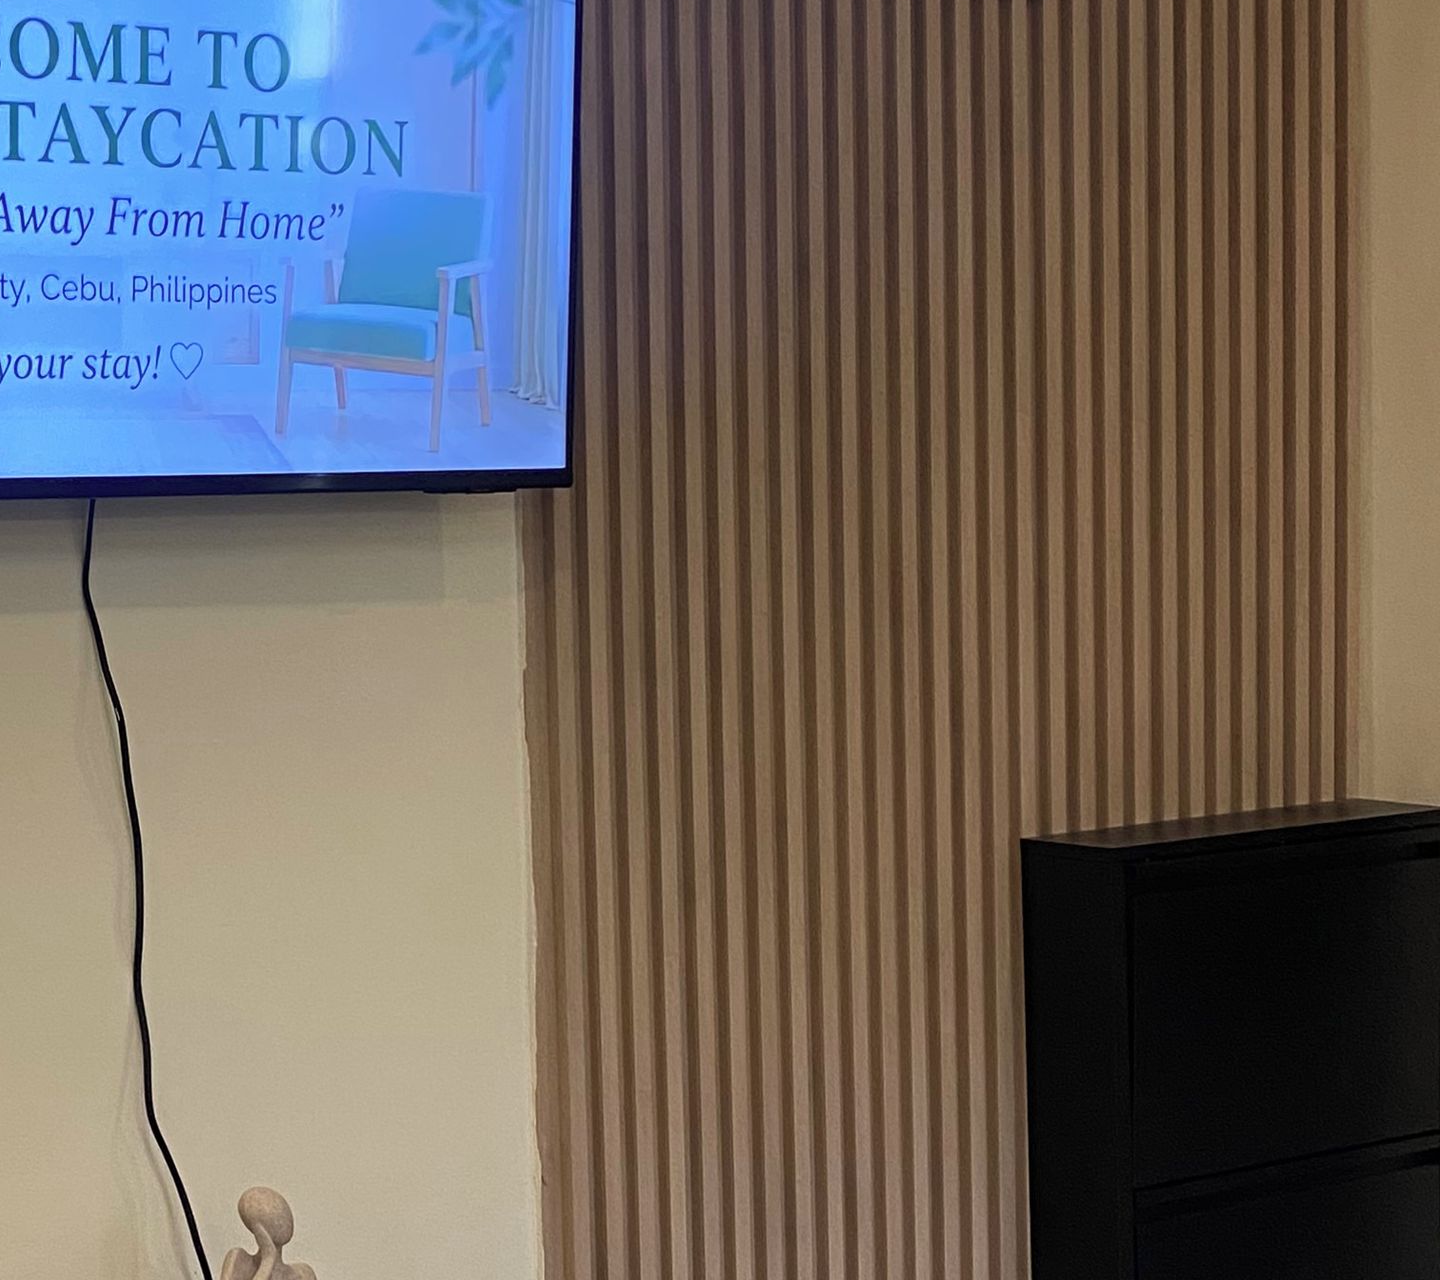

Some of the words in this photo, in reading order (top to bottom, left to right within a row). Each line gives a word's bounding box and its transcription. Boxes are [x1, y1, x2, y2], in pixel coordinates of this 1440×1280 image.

[198, 31, 291, 93] TO
[107, 197, 204, 239] From
[218, 201, 344, 243] Home”
[41, 273, 122, 305] Cebu,
[131, 275, 278, 310] Philippines
[82, 345, 163, 390] stay!
